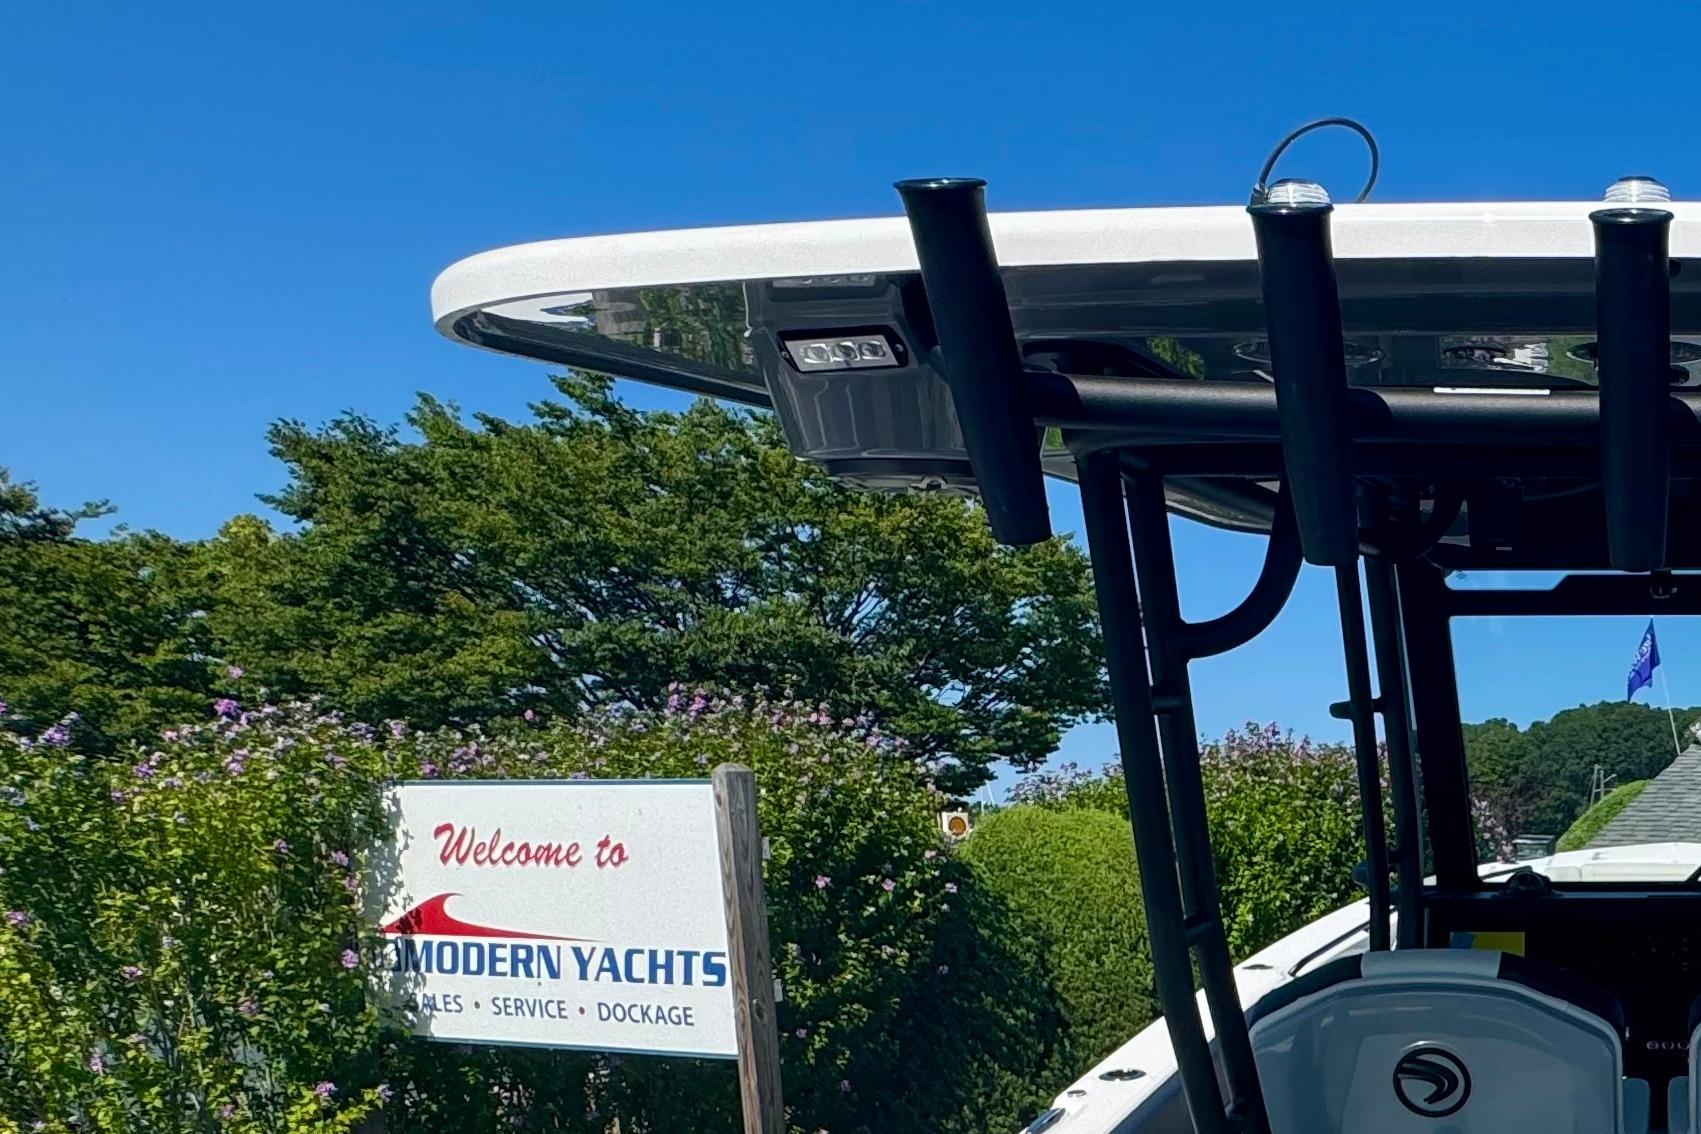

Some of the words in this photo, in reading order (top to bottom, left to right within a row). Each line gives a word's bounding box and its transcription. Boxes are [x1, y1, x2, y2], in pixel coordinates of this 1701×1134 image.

[434, 822, 582, 867] Welcome
[594, 834, 629, 868] to
[570, 945, 727, 987] YACHTS
[491, 996, 569, 1019] SERVICE
[597, 1002, 695, 1027] DOCKAGE
